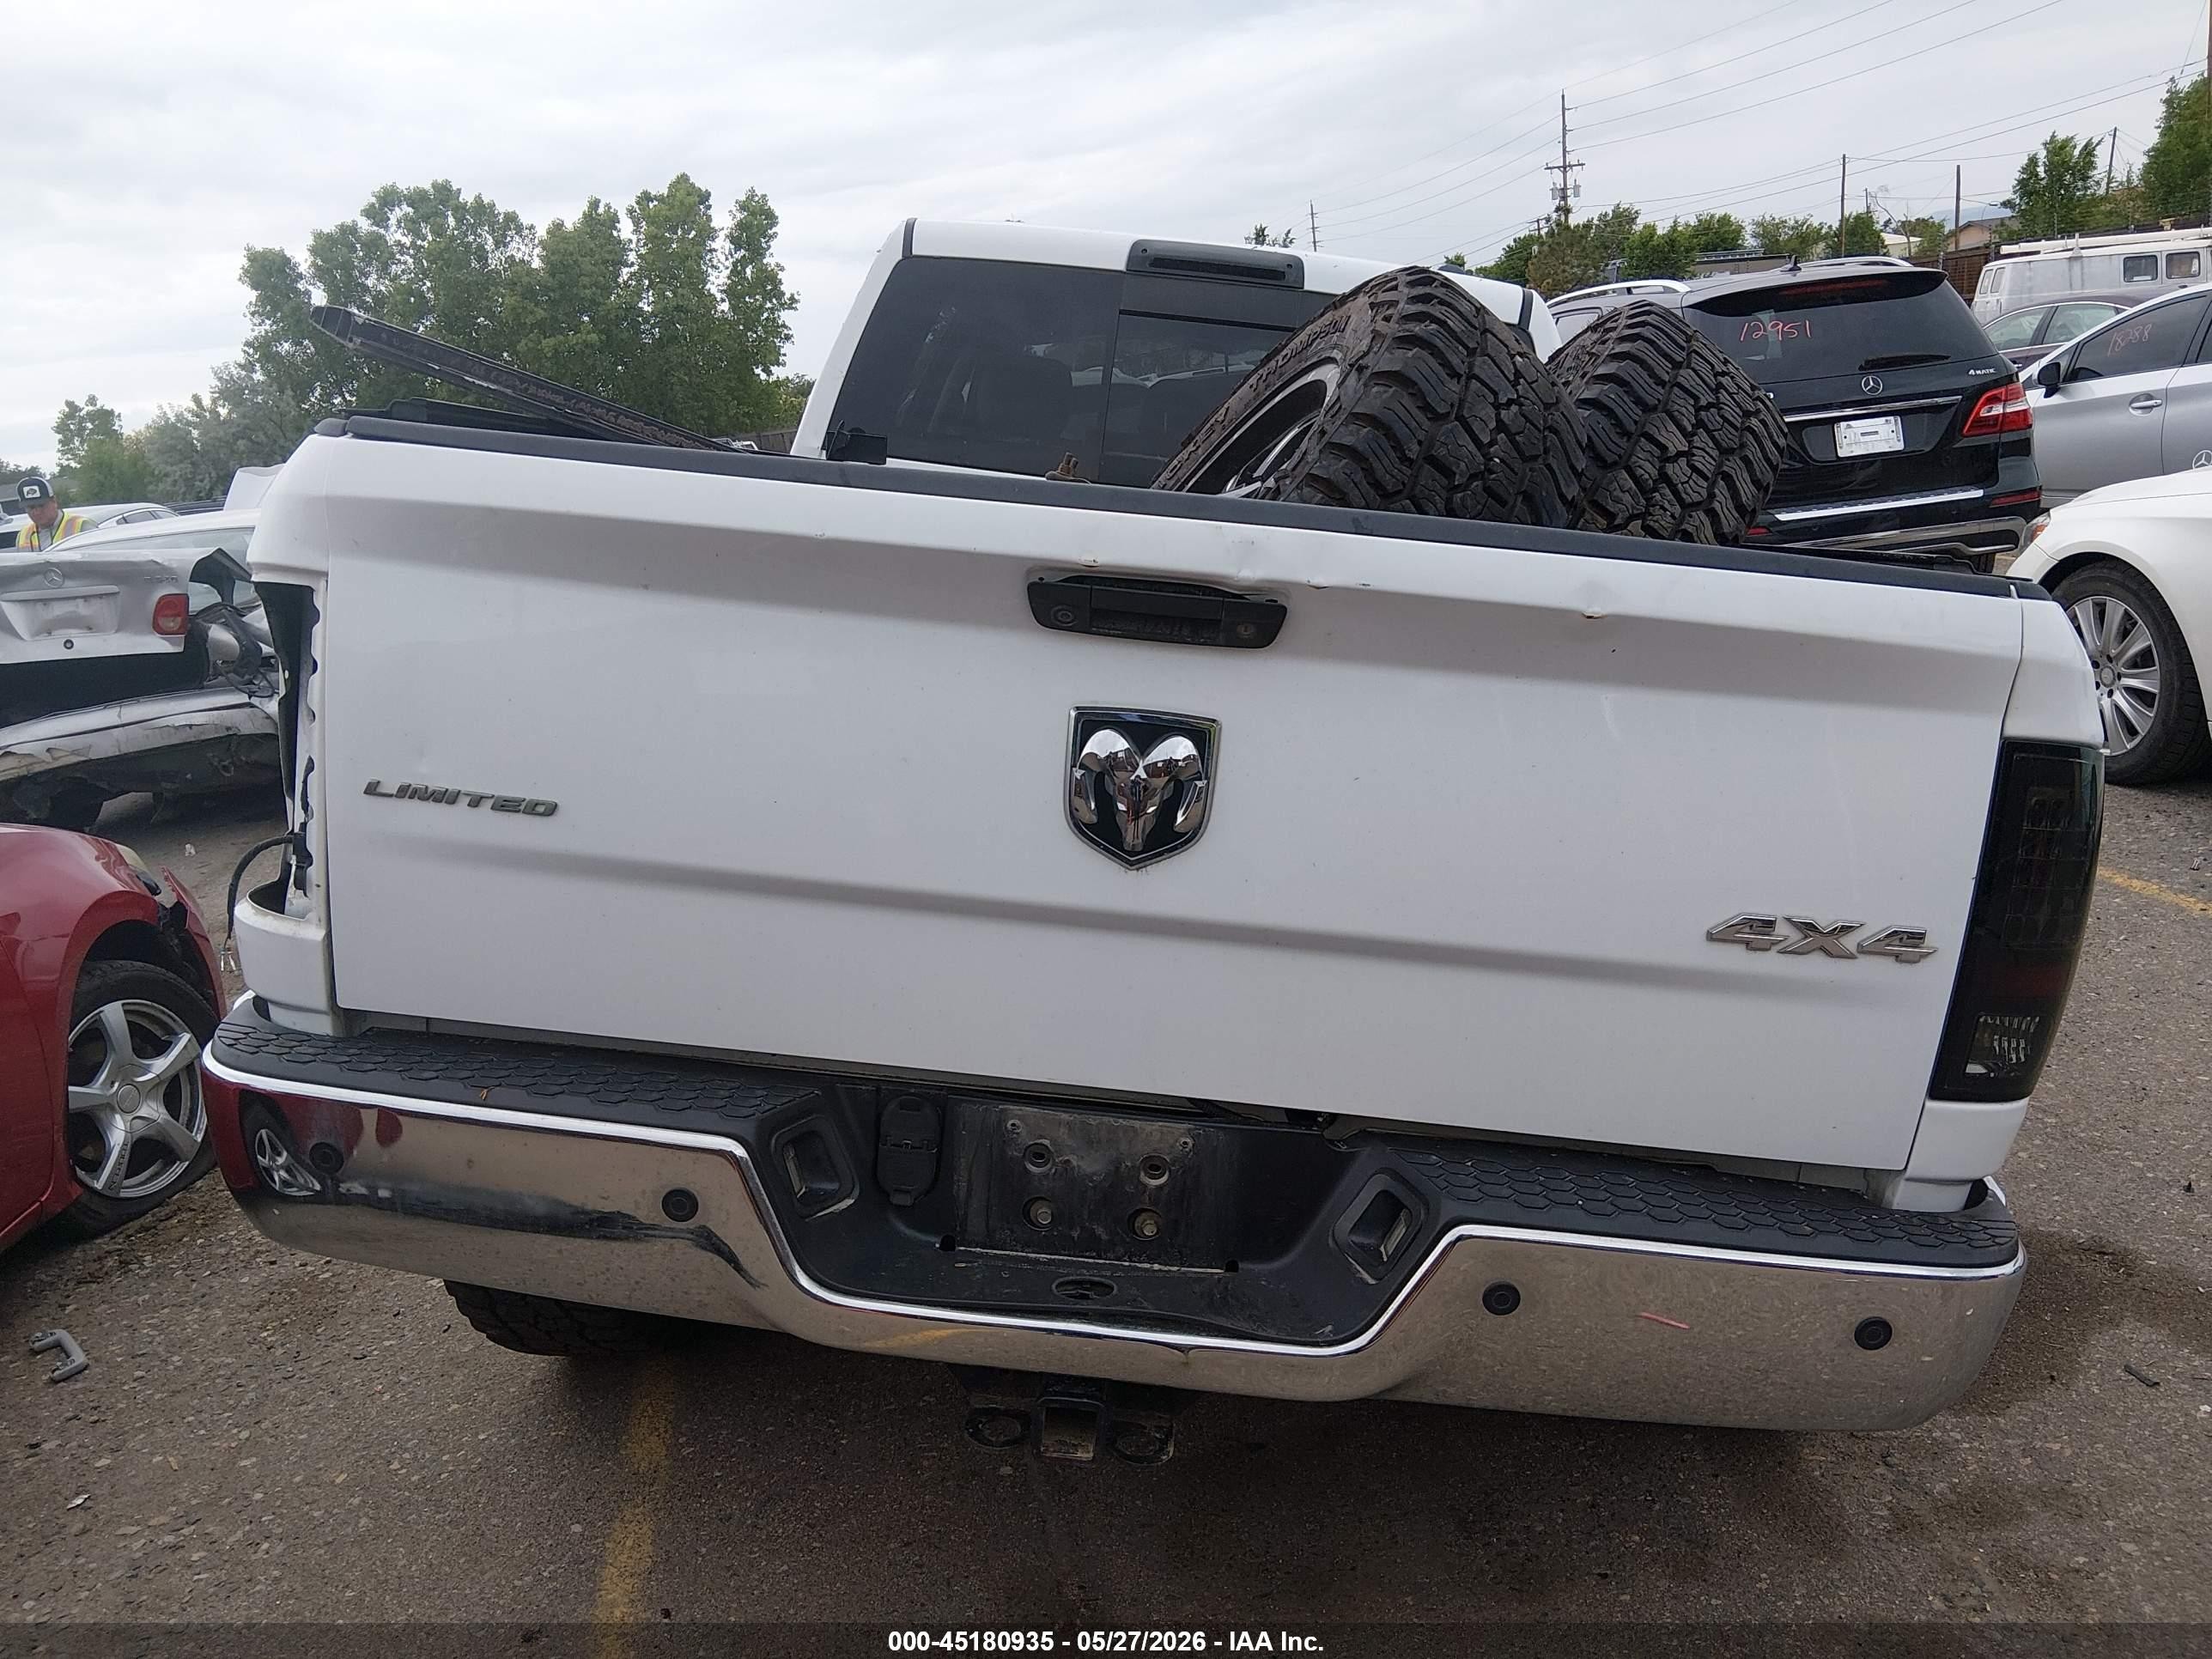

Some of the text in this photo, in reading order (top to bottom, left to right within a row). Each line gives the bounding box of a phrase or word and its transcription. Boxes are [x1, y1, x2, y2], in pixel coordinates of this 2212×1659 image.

[1740, 319, 1812, 342] 12951
[1158, 403, 1231, 489] ICKEY
[363, 778, 559, 817] LIMITED
[1706, 912, 1938, 963] 4X4
